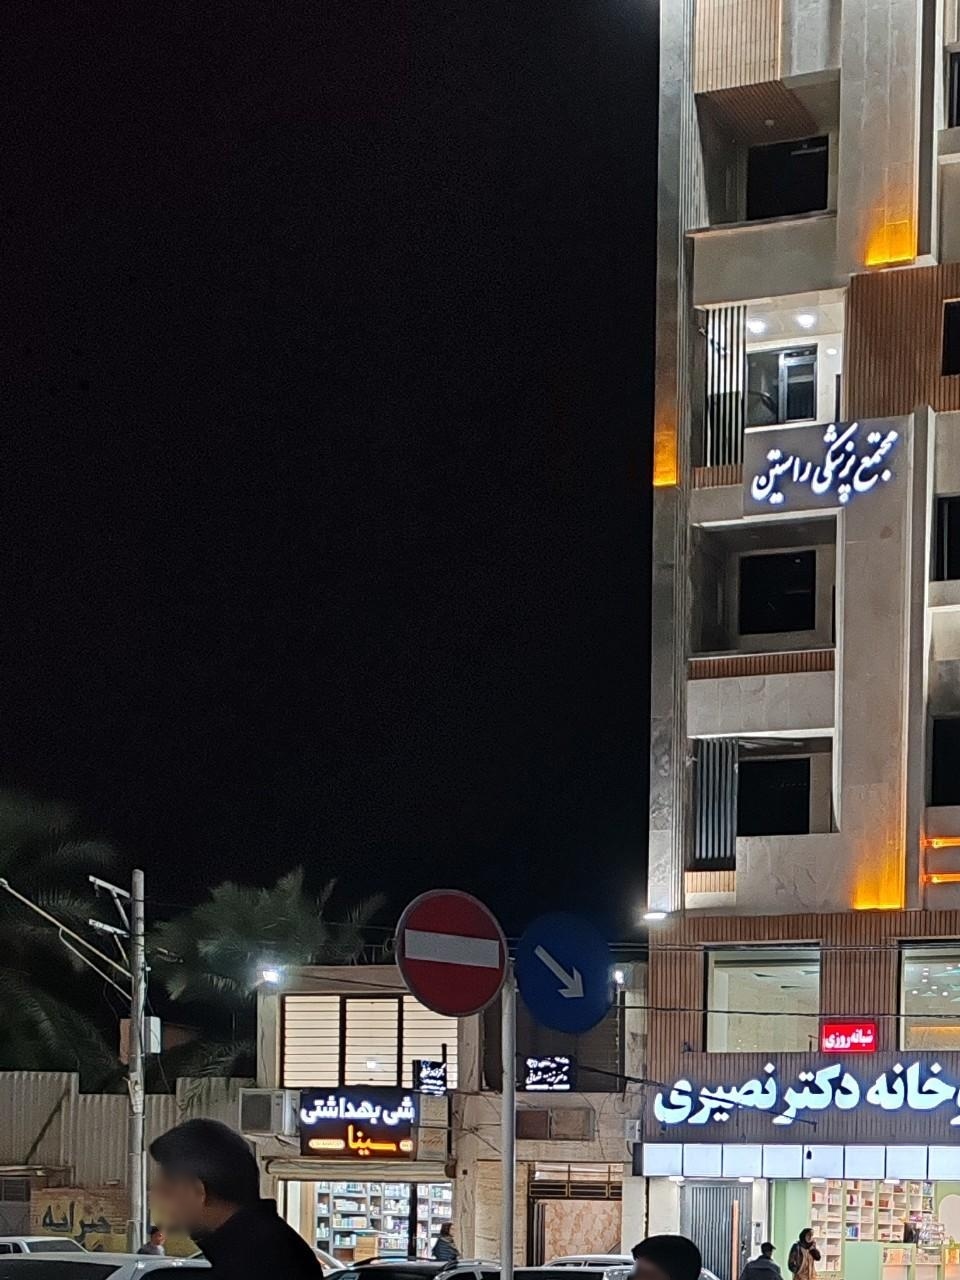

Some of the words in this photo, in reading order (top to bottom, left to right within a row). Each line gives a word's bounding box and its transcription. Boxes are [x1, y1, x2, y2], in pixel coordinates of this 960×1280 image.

[751, 449, 812, 504] راستین
[811, 422, 859, 503] پزشکی
[853, 430, 899, 492] مجتمع
[300, 1095, 382, 1125] بهداشتی
[653, 1062, 777, 1125] نصیری
[772, 1063, 861, 1126] دکتر
[347, 1124, 397, 1156] سینا
